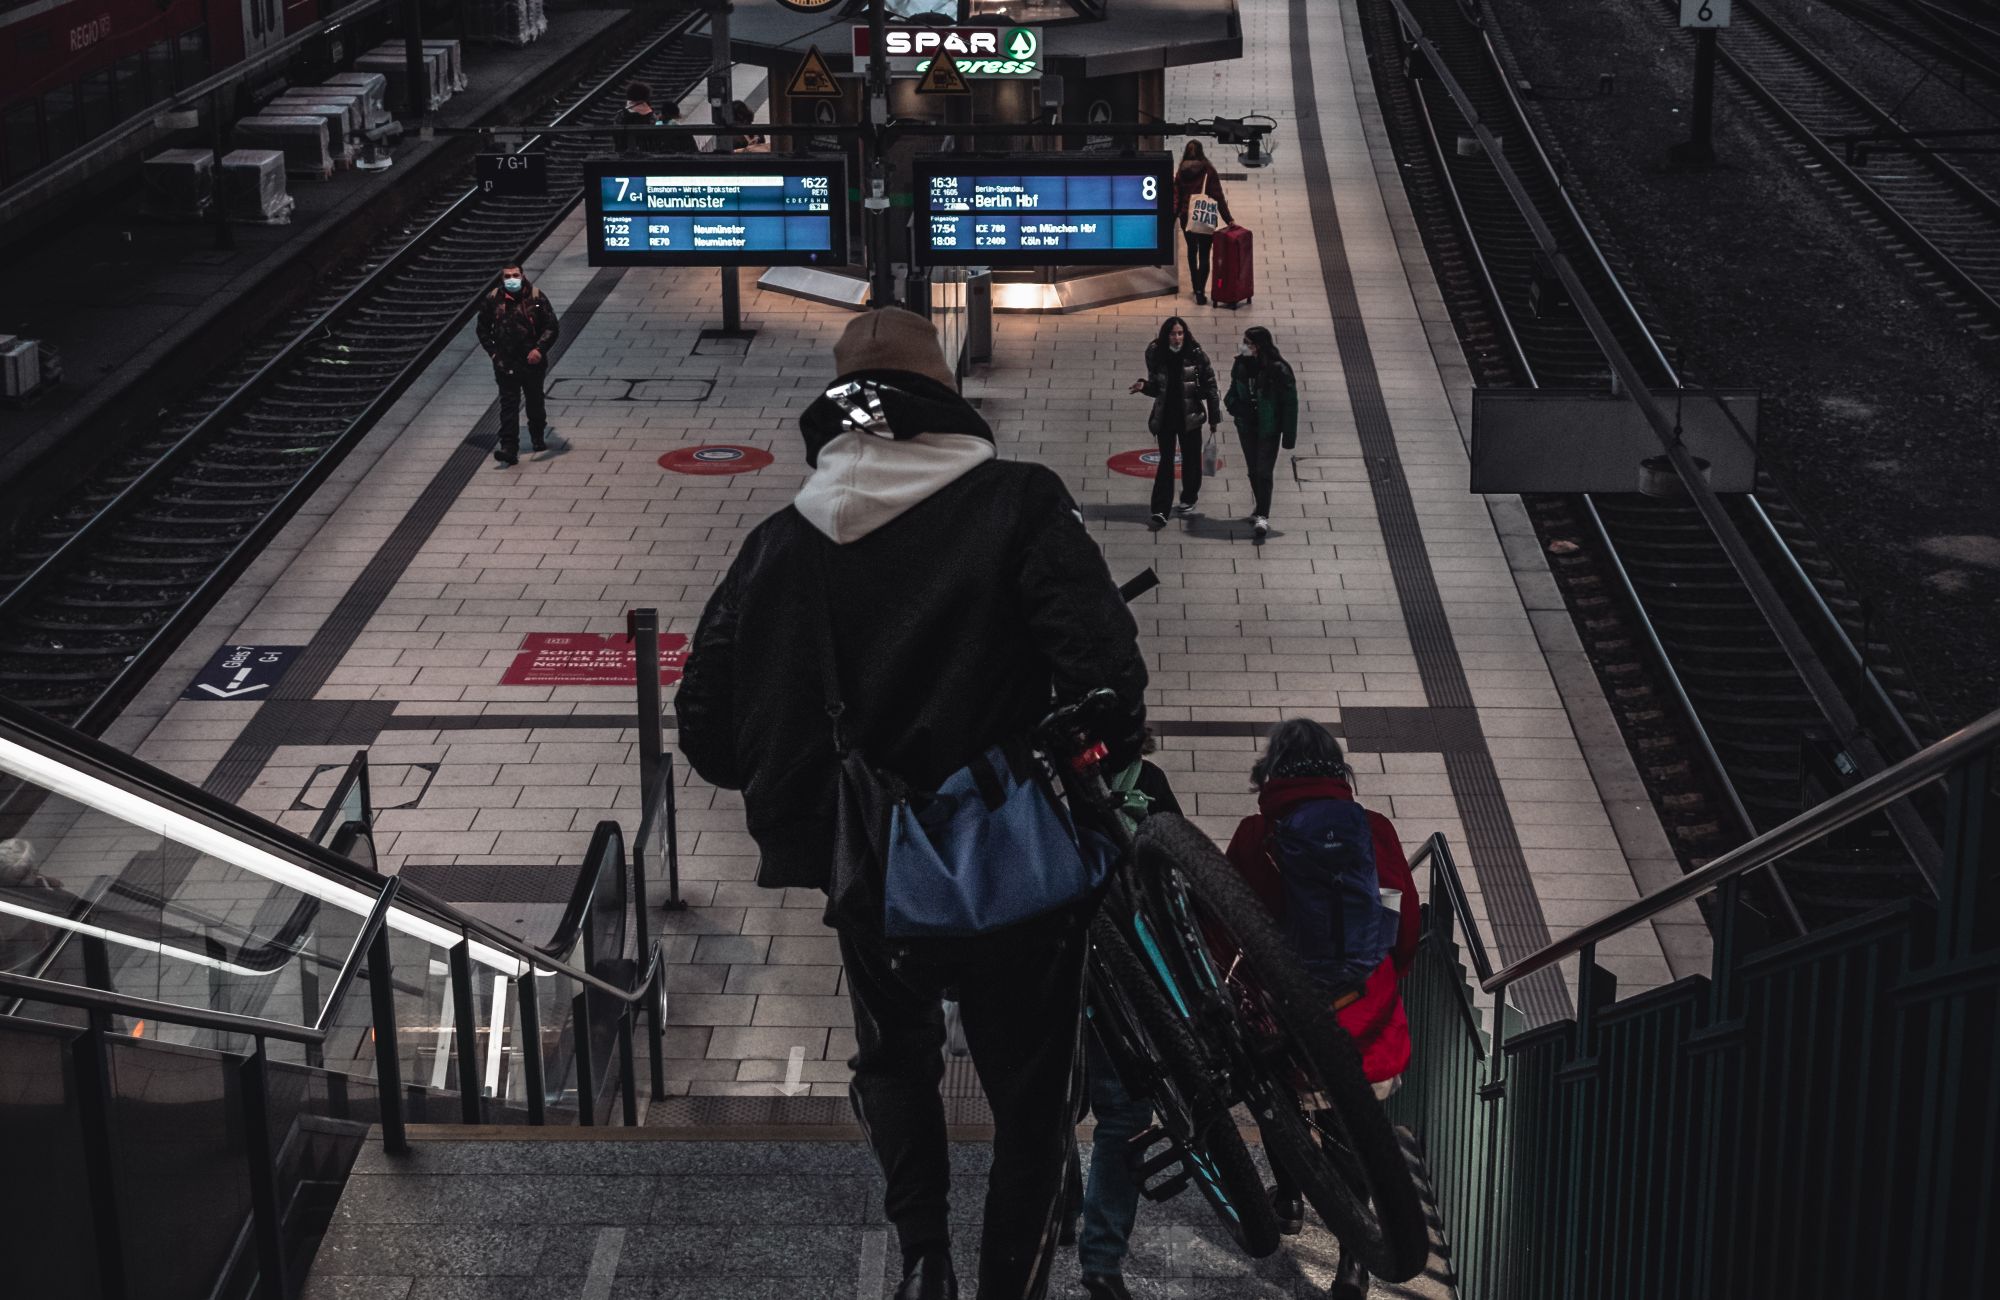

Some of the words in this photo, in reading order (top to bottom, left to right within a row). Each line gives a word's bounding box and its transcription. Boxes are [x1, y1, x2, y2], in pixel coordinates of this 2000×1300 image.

[1698, 0, 1713, 21] 6
[70, 20, 99, 51] REGIO
[886, 32, 996, 54] SPAR
[916, 60, 1037, 75] epress
[496, 157, 504, 169] 7
[508, 156, 528, 169] G-I
[801, 178, 828, 188] 16:22
[931, 177, 958, 188] 16:34
[1142, 176, 1157, 201] 8
[615, 178, 630, 202] 7
[630, 193, 643, 202] G-I
[647, 195, 725, 208] Neumünster
[975, 194, 1012, 207] Berlin
[1016, 194, 1039, 207] Hbf
[1192, 210, 1218, 225] STAR
[604, 224, 630, 234] 17:22
[649, 225, 670, 233] RE70
[693, 225, 746, 234] Neumünster
[931, 224, 956, 233] 17:54
[976, 224, 989, 233] ICE
[1021, 225, 1037, 233] von
[1039, 224, 1078, 233] München
[1080, 224, 1097, 233] Hbf
[605, 237, 630, 247] 18:22
[649, 237, 670, 246] RE70
[694, 237, 746, 247] Neumünster
[976, 237, 984, 245] IC
[1021, 236, 1041, 245] Köln
[1043, 236, 1059, 245] Hbf
[222, 650, 252, 668] Gleis
[258, 651, 283, 662] G-I
